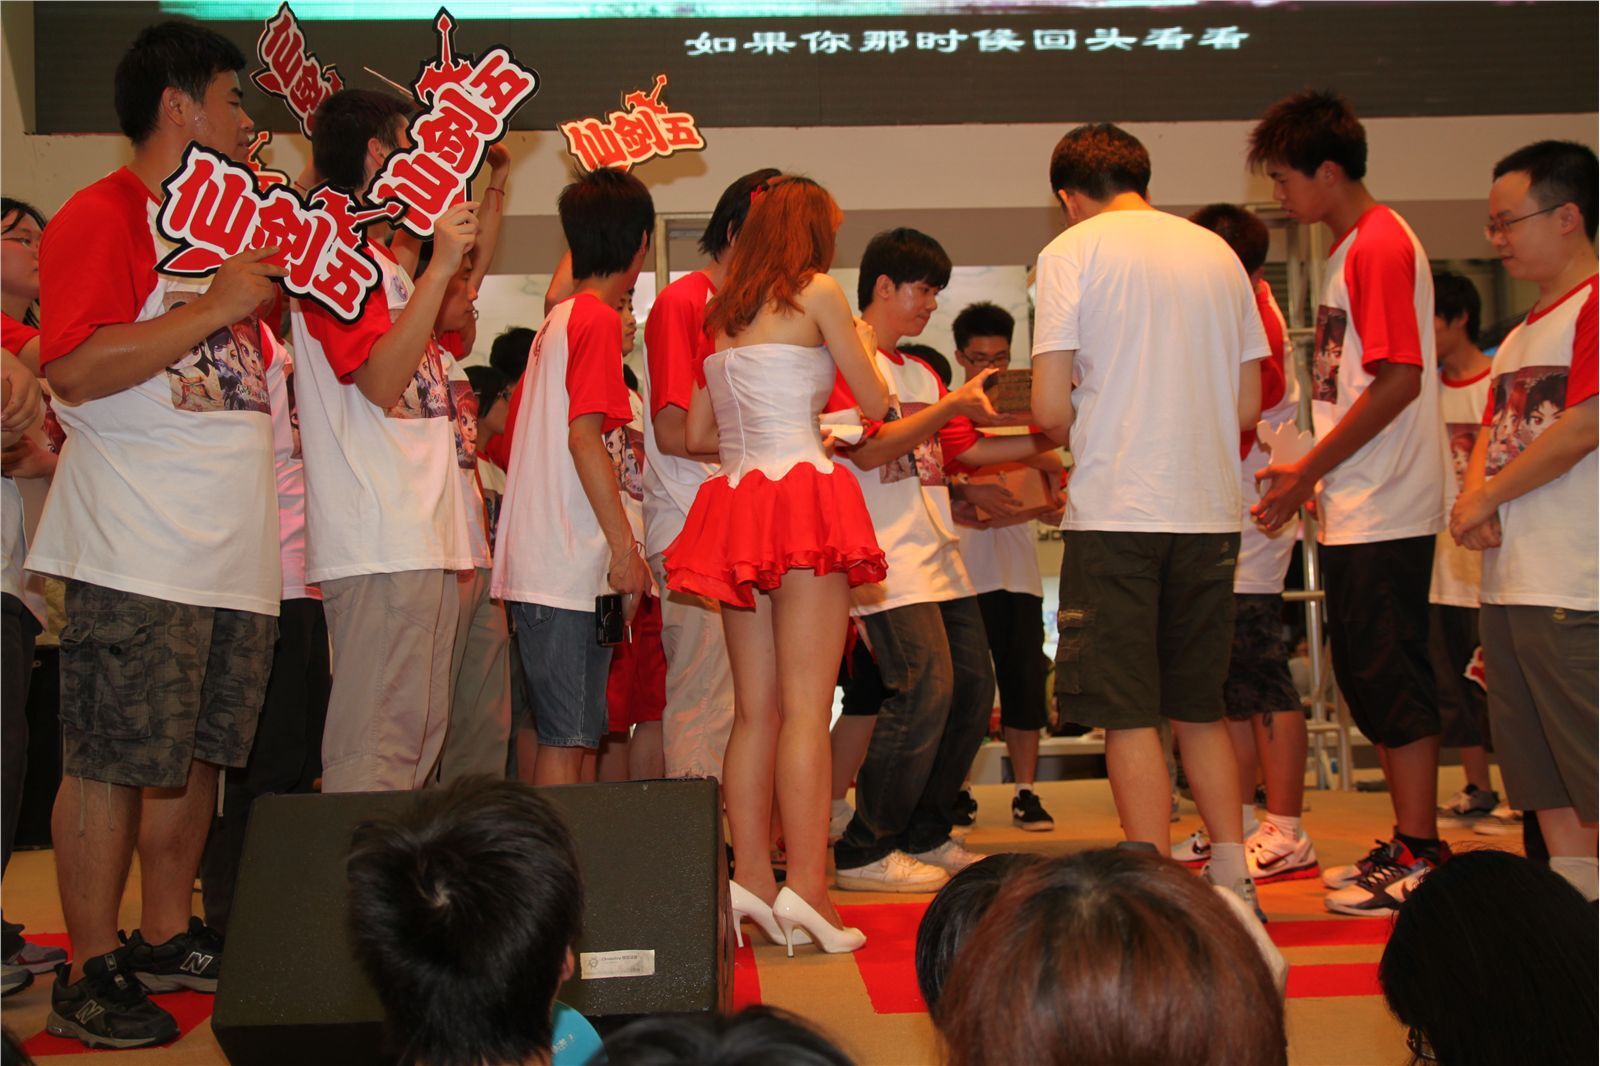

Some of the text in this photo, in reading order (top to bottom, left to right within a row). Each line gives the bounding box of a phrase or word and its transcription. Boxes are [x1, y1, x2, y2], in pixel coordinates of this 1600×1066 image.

[684, 26, 1250, 56] 如果你那时候回头看看
[374, 52, 531, 233] 仙剑五
[566, 108, 702, 172] 仙剑五
[167, 155, 376, 316] 仙剑五
